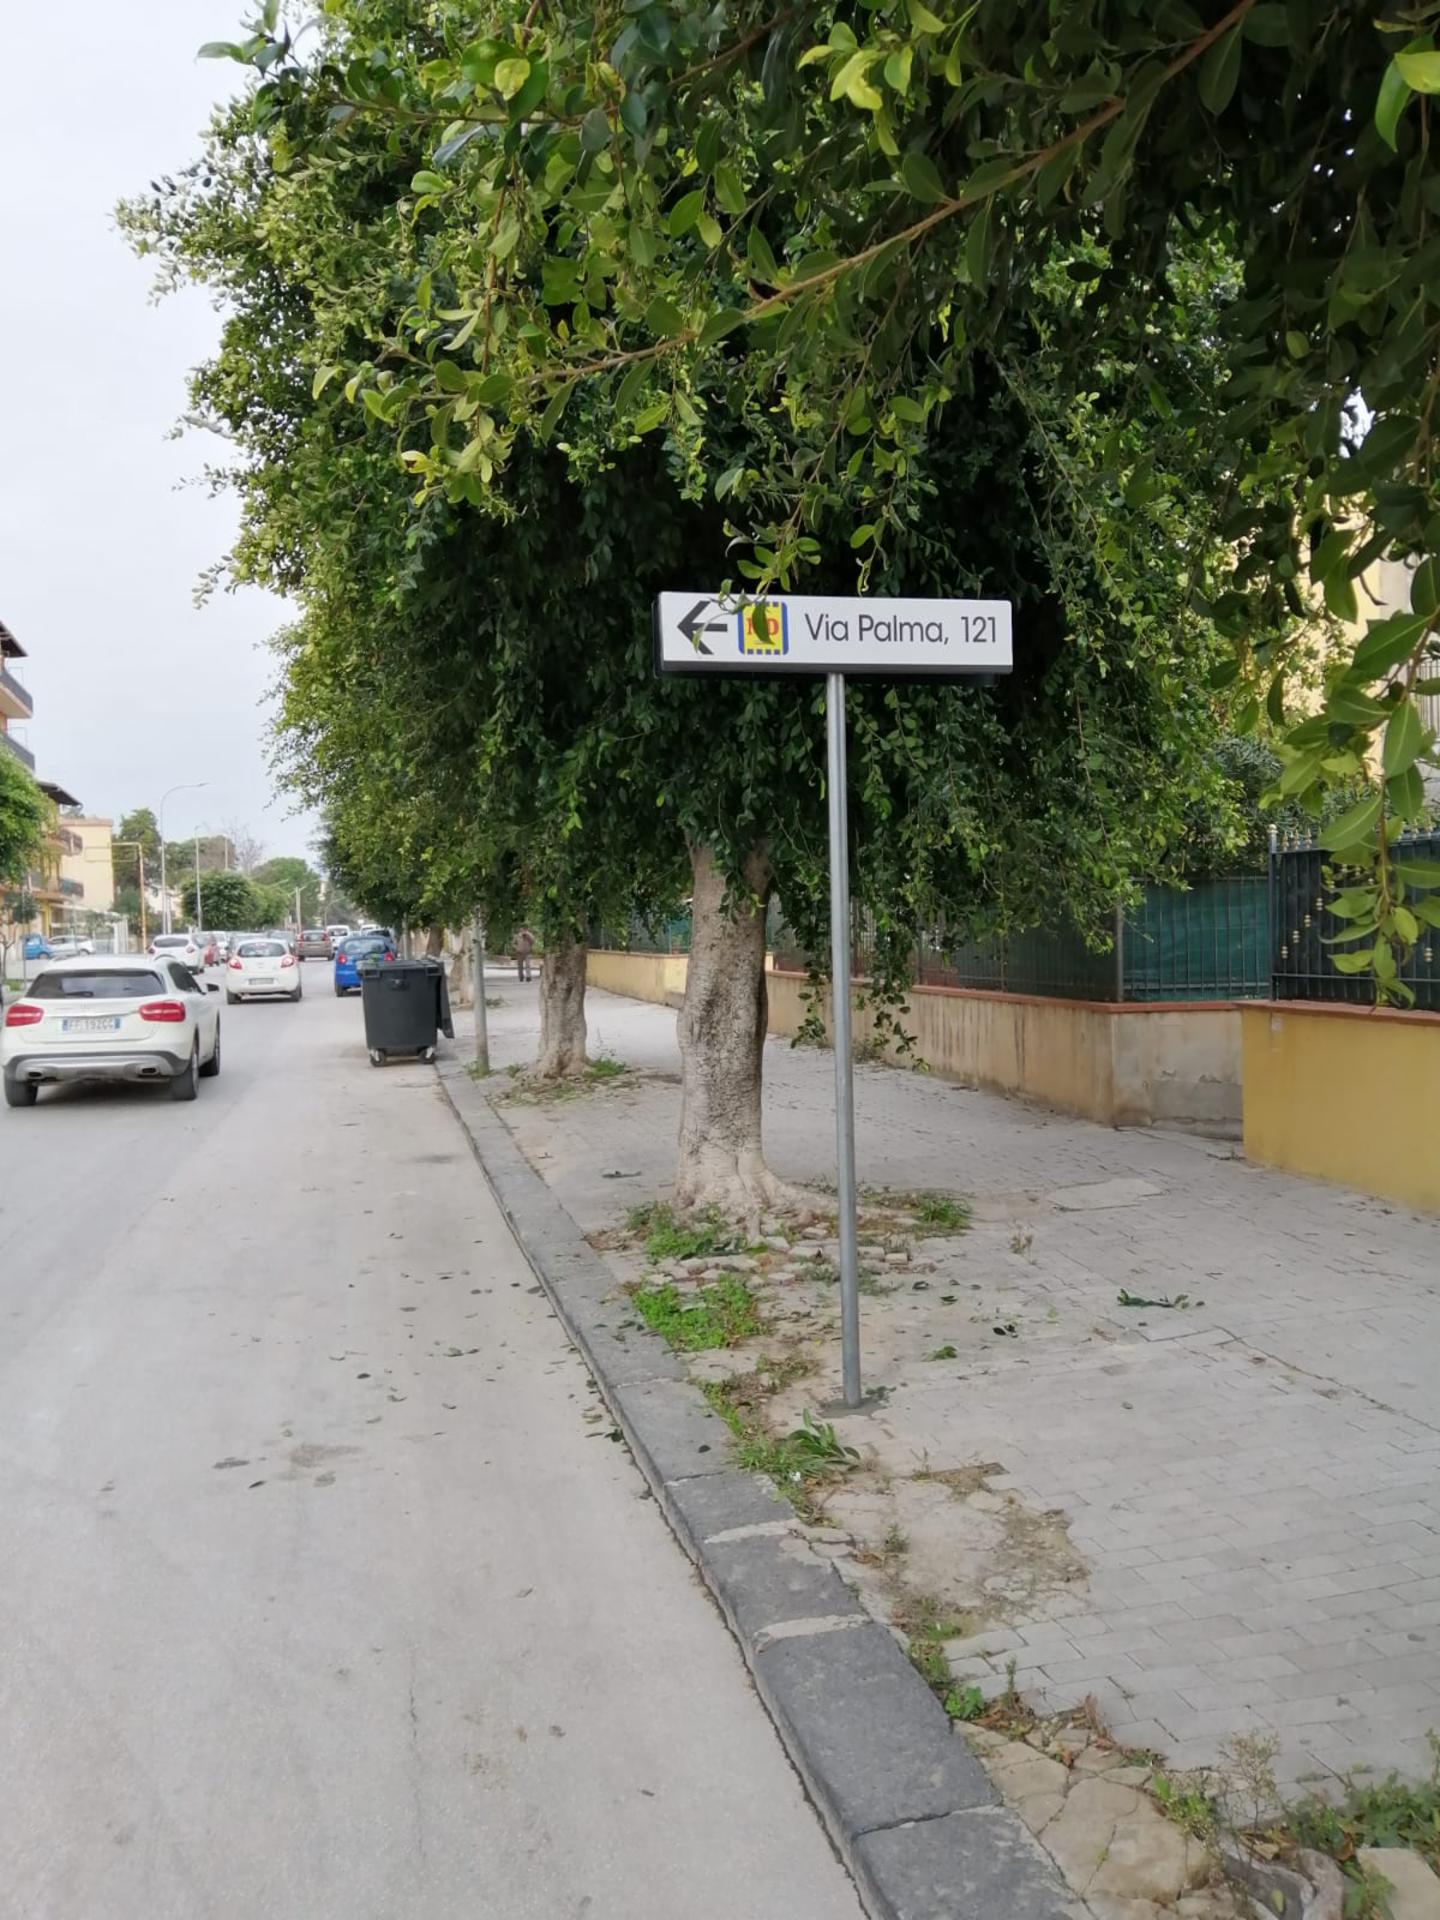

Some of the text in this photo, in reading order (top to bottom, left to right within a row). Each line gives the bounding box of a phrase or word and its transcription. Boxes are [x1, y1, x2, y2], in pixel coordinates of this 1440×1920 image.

[804, 613, 849, 642] Via
[858, 614, 949, 646] Palma,
[960, 615, 997, 643] 121
